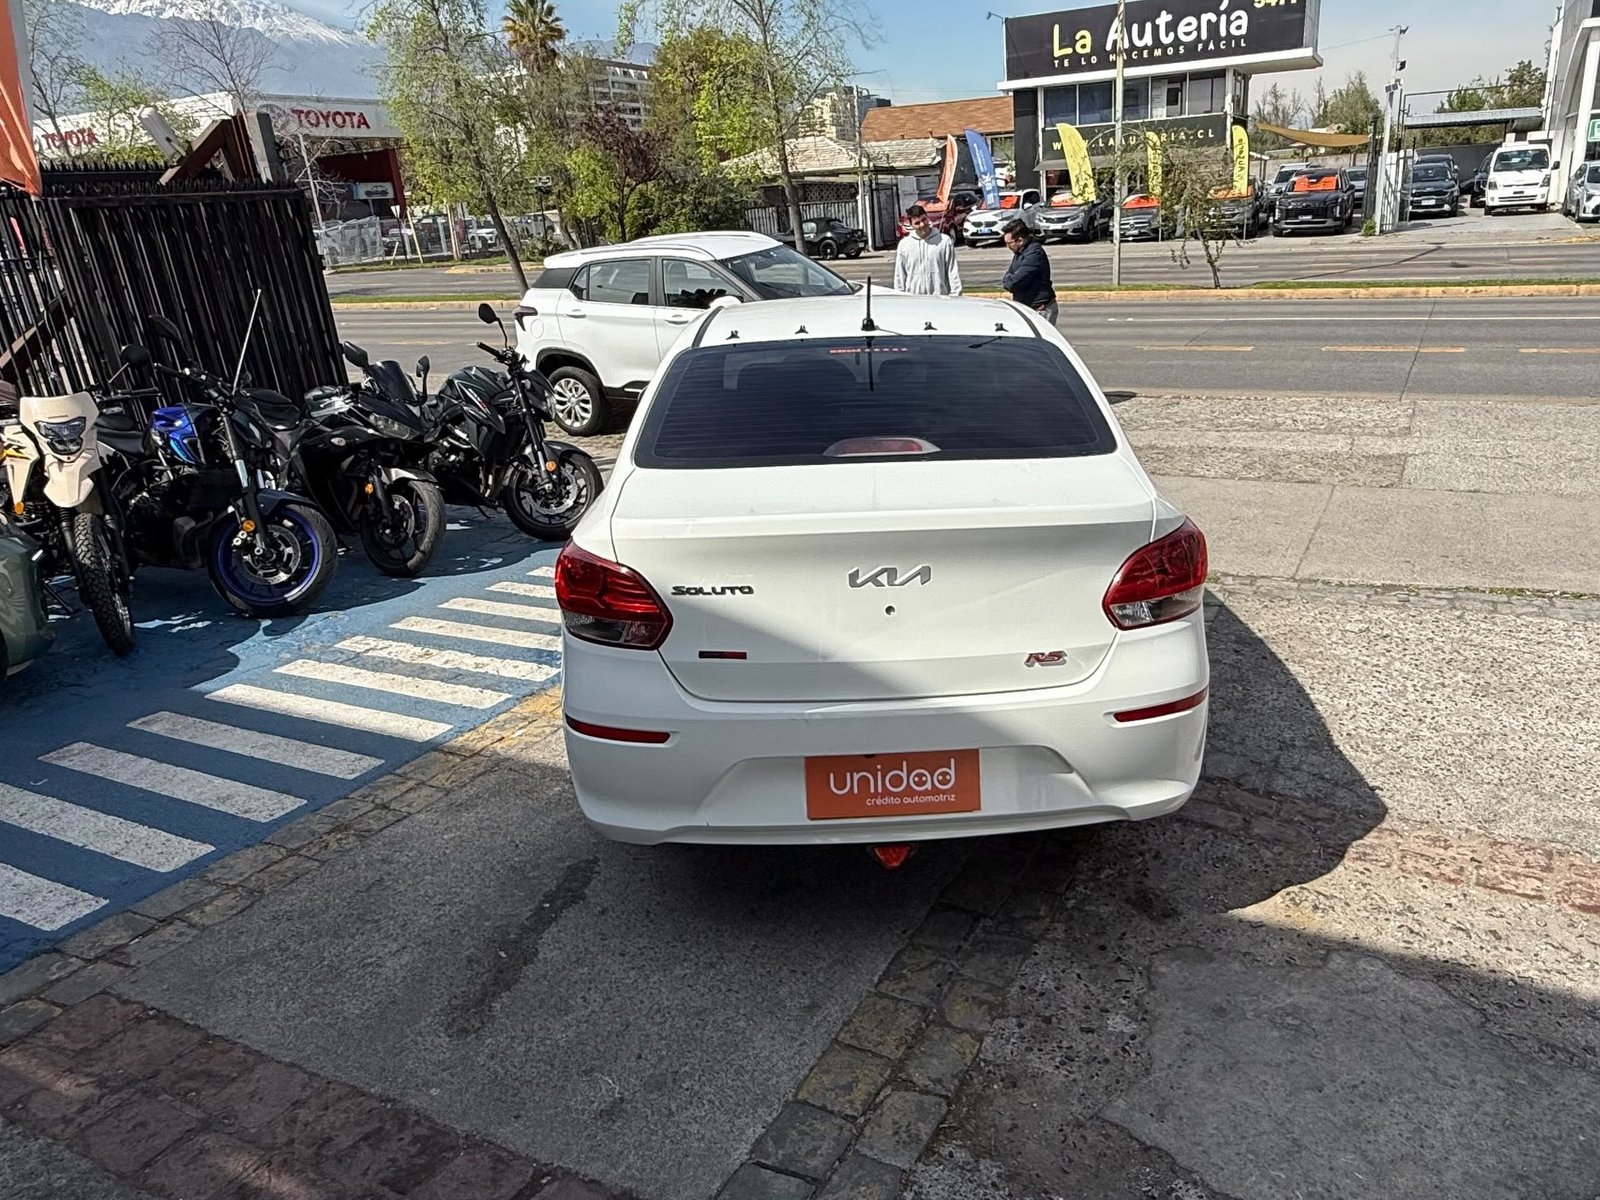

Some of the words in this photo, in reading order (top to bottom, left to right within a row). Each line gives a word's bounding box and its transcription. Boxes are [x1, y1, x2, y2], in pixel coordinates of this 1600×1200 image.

[1053, 23, 1092, 57] La
[1105, 0, 1249, 51] Autería
[1053, 59, 1069, 67] TE
[1081, 56, 1097, 65] LO
[1197, 38, 1247, 52] FÁCIL
[291, 109, 371, 129] TOYOTA
[848, 565, 931, 588] KIA
[671, 585, 754, 596] SOLUTO
[1024, 650, 1068, 668] RS
[829, 757, 956, 795] unidad
[866, 796, 901, 807] crédito
[903, 793, 956, 805] automotriz
